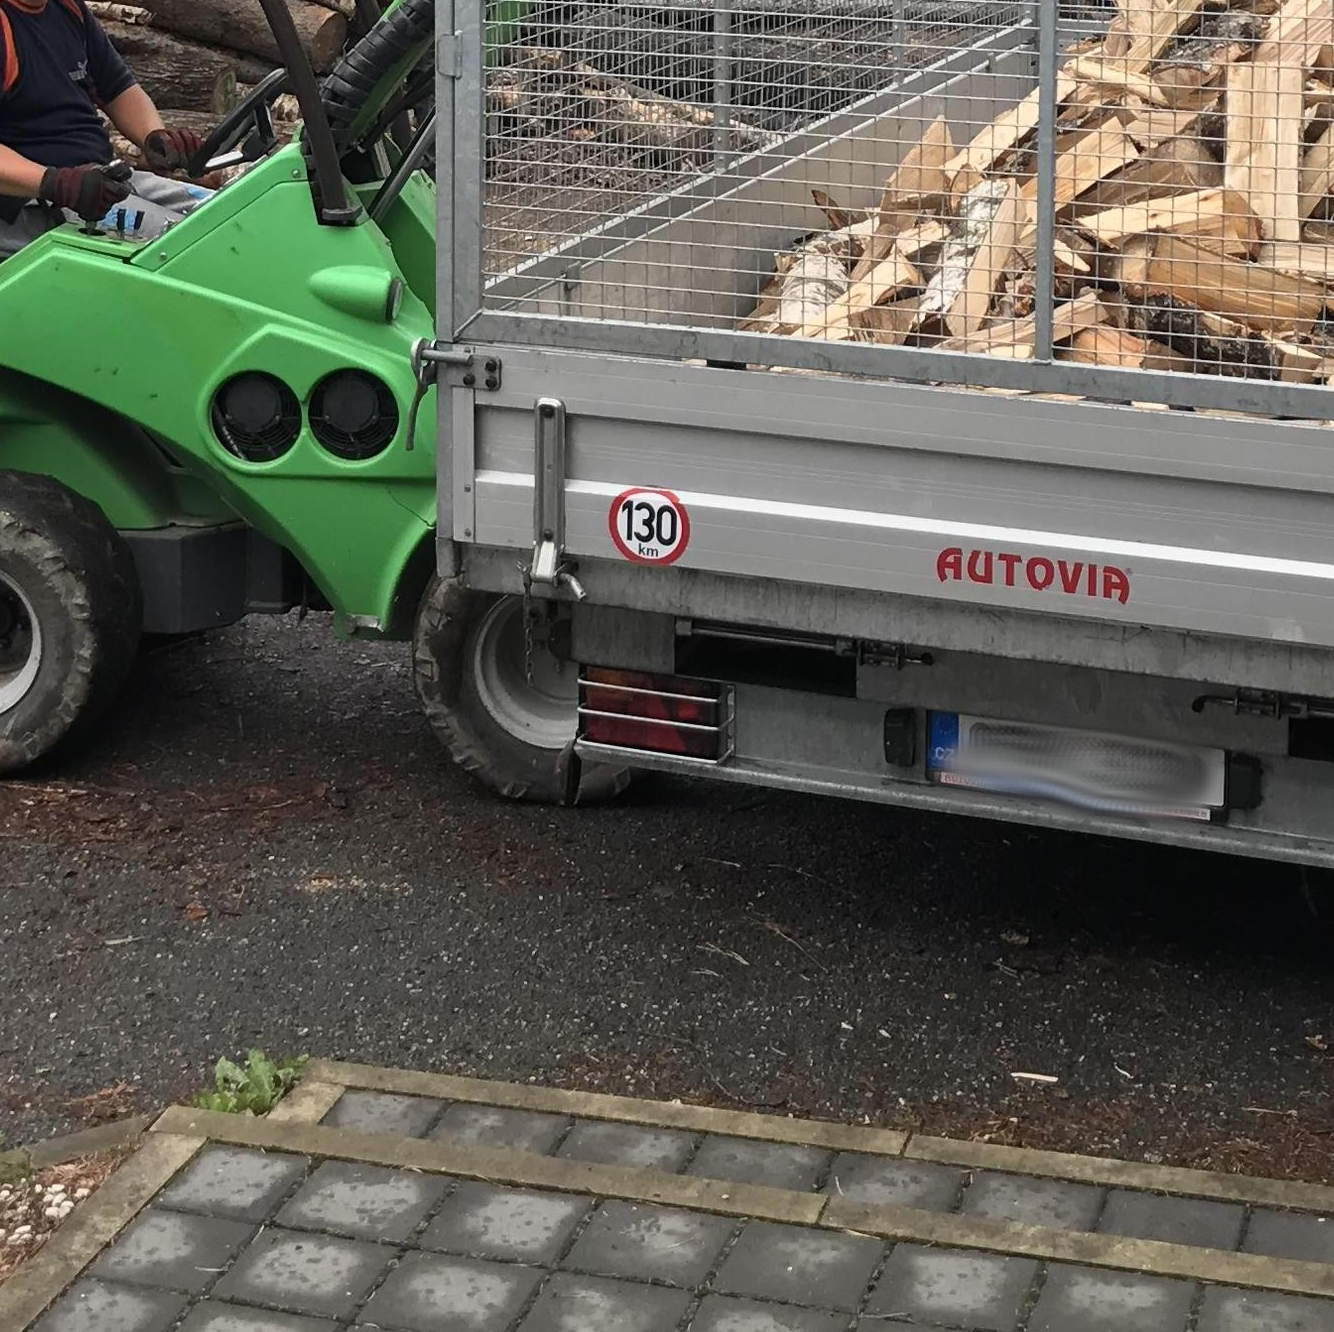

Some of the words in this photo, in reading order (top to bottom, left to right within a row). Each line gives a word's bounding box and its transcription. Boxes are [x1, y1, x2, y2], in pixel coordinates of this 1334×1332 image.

[622, 500, 677, 546] 130
[638, 543, 659, 557] km
[936, 547, 1131, 605] AUTOVIA
